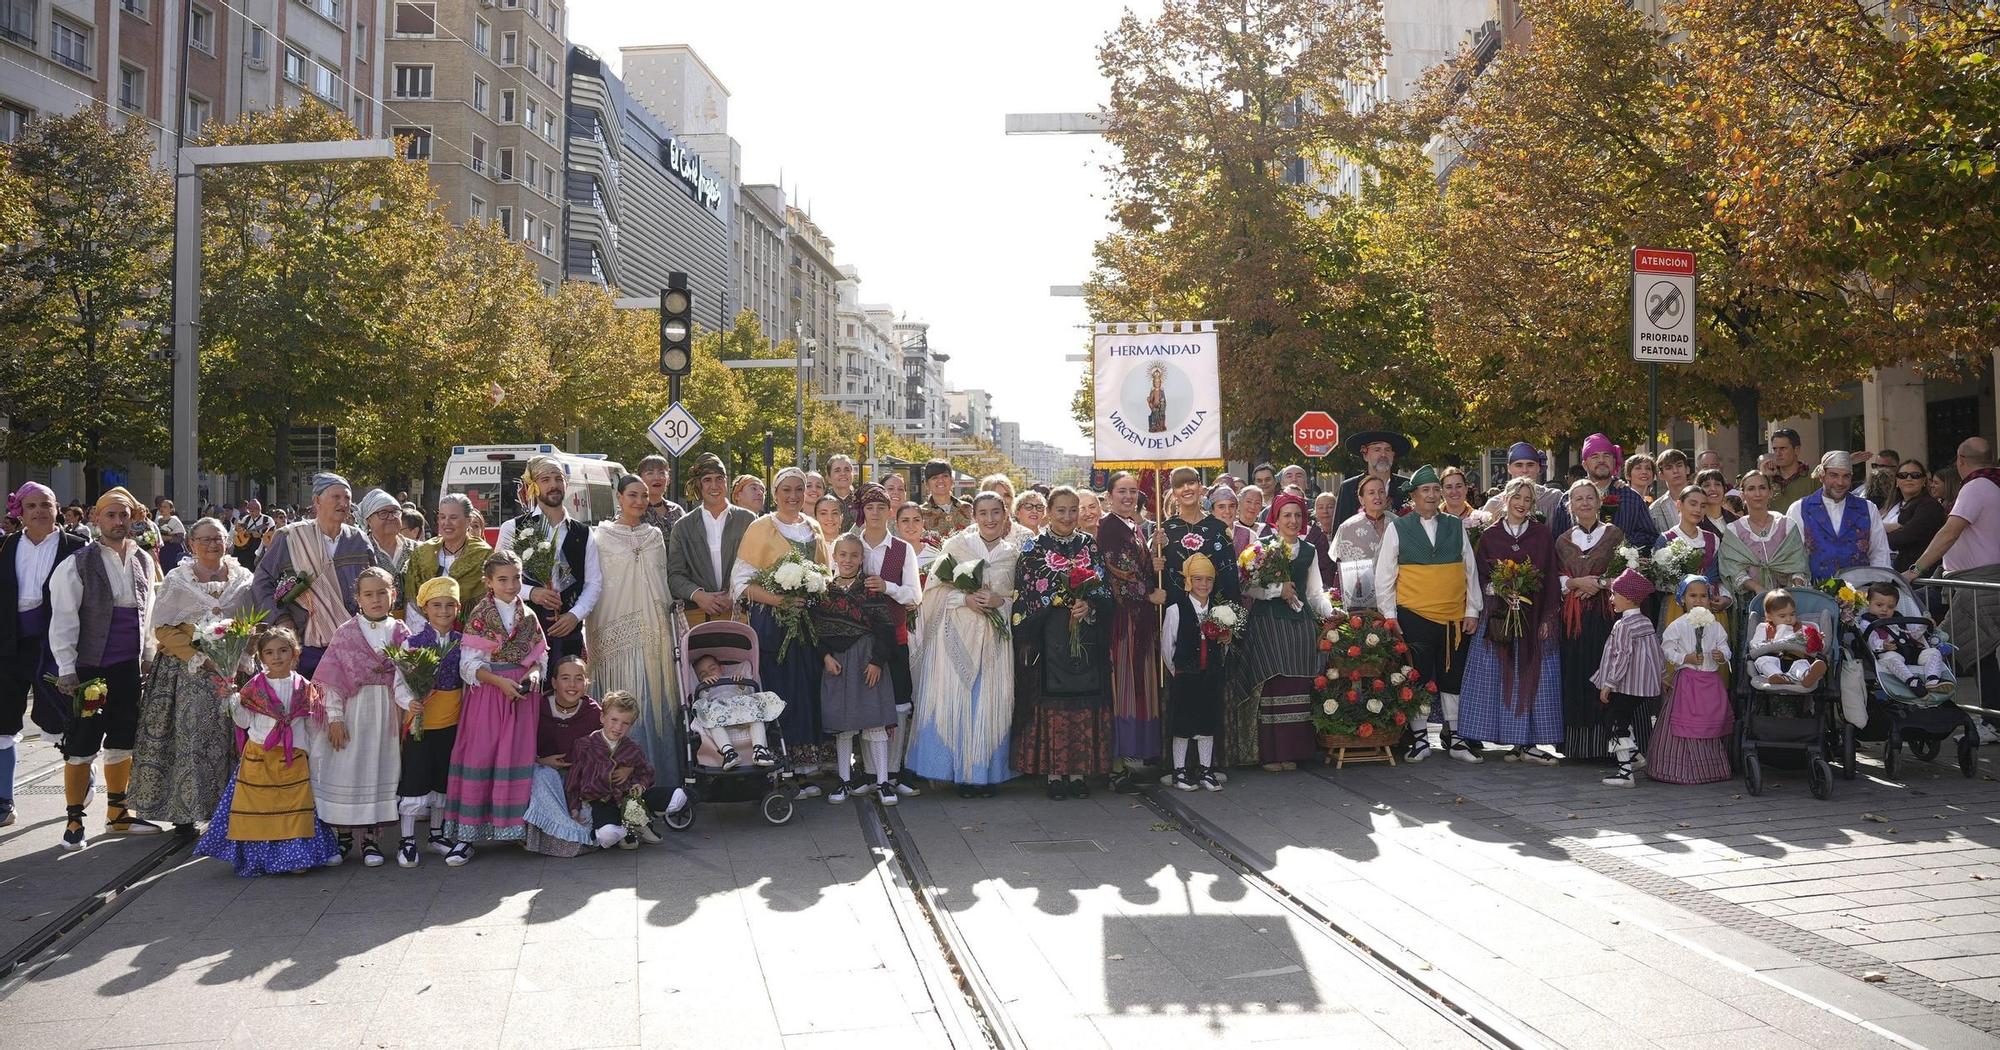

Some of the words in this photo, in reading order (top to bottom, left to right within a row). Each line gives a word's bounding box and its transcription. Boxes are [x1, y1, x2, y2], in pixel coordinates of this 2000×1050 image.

[670, 138, 679, 172] El
[679, 148, 698, 187] Corte
[1641, 256, 1688, 268] ATENCIÓN
[1649, 294, 1680, 317] 20
[1640, 332, 1689, 343] PRIORIDAD
[1110, 344, 1201, 357] HERMANDAD
[1641, 345, 1688, 356] PEATONAL
[664, 420, 688, 438] 30
[1109, 410, 1147, 447] VIRGEN
[1147, 438, 1163, 449] DE
[1165, 434, 1182, 448] LA
[1181, 409, 1207, 440] SILLA
[1298, 428, 1334, 440] STOP
